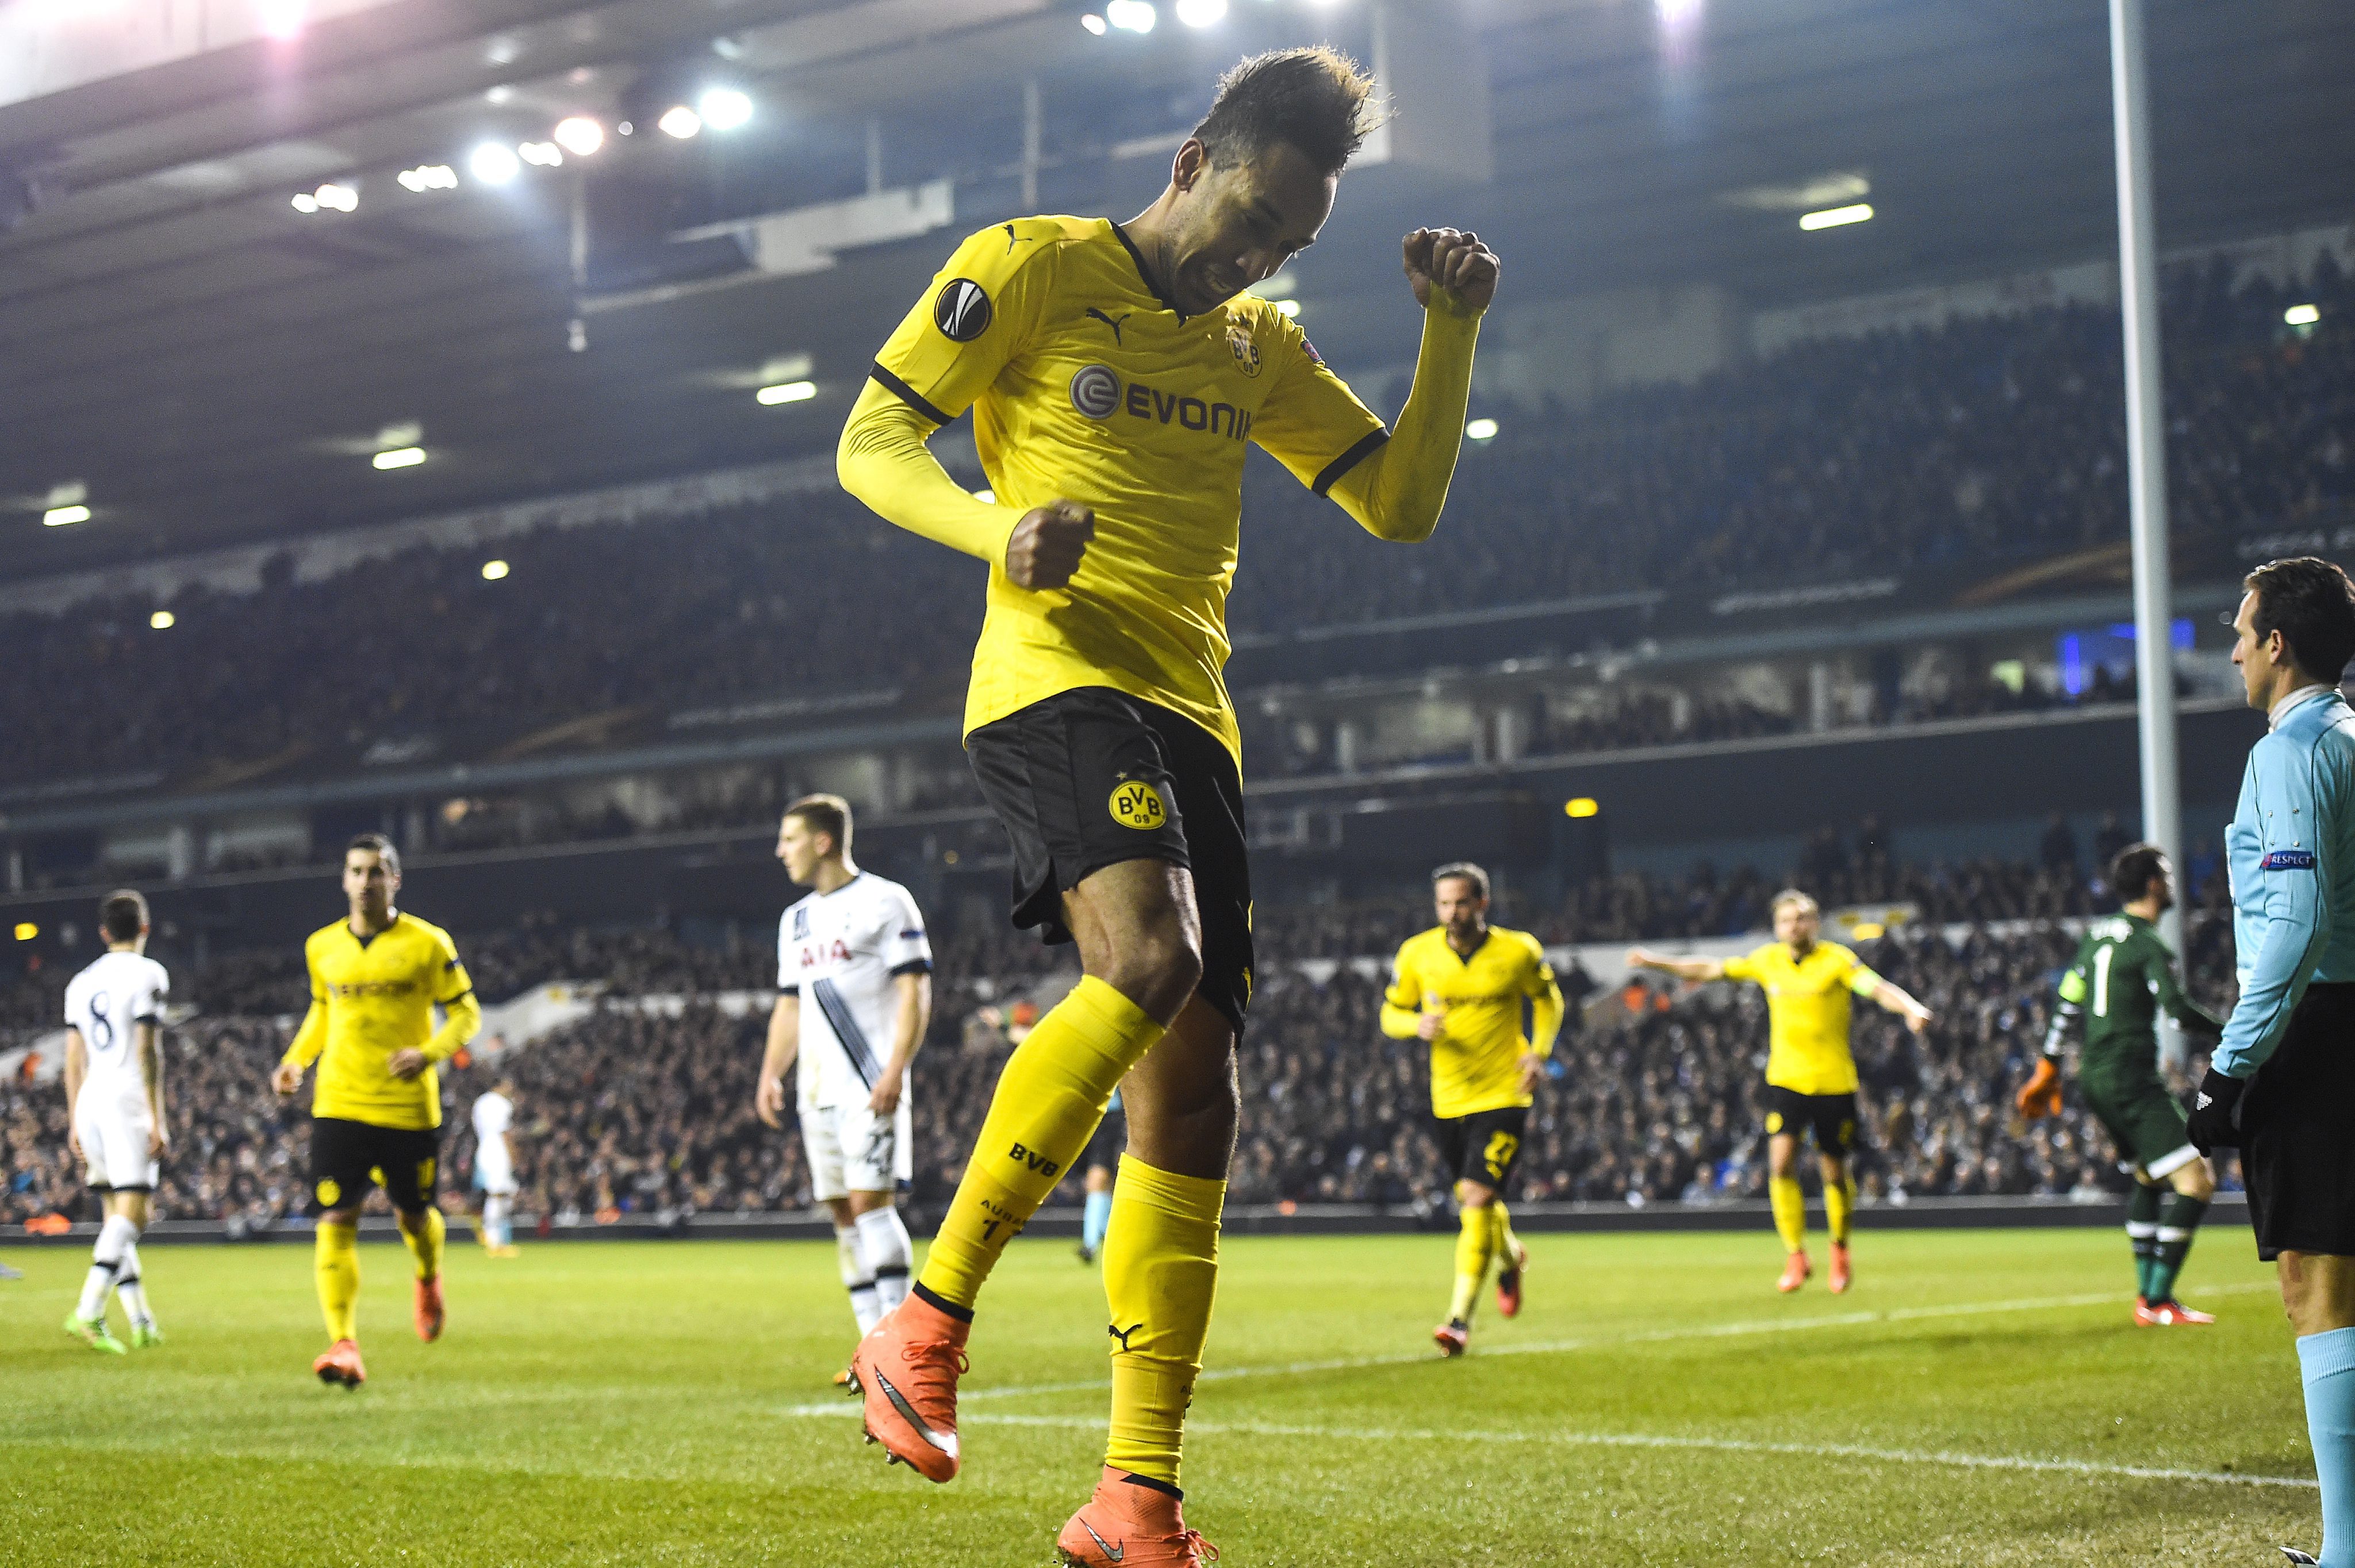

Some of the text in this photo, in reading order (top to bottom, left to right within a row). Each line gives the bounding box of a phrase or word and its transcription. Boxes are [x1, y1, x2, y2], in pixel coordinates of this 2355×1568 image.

[1118, 787, 1160, 816] BVB
[1134, 814, 1150, 824] 09
[2272, 855, 2311, 865] RESPECT
[800, 939, 852, 969] AIA
[2093, 943, 2114, 1018] 1
[88, 990, 115, 1052] 8
[1008, 1143, 1058, 1177] BVB
